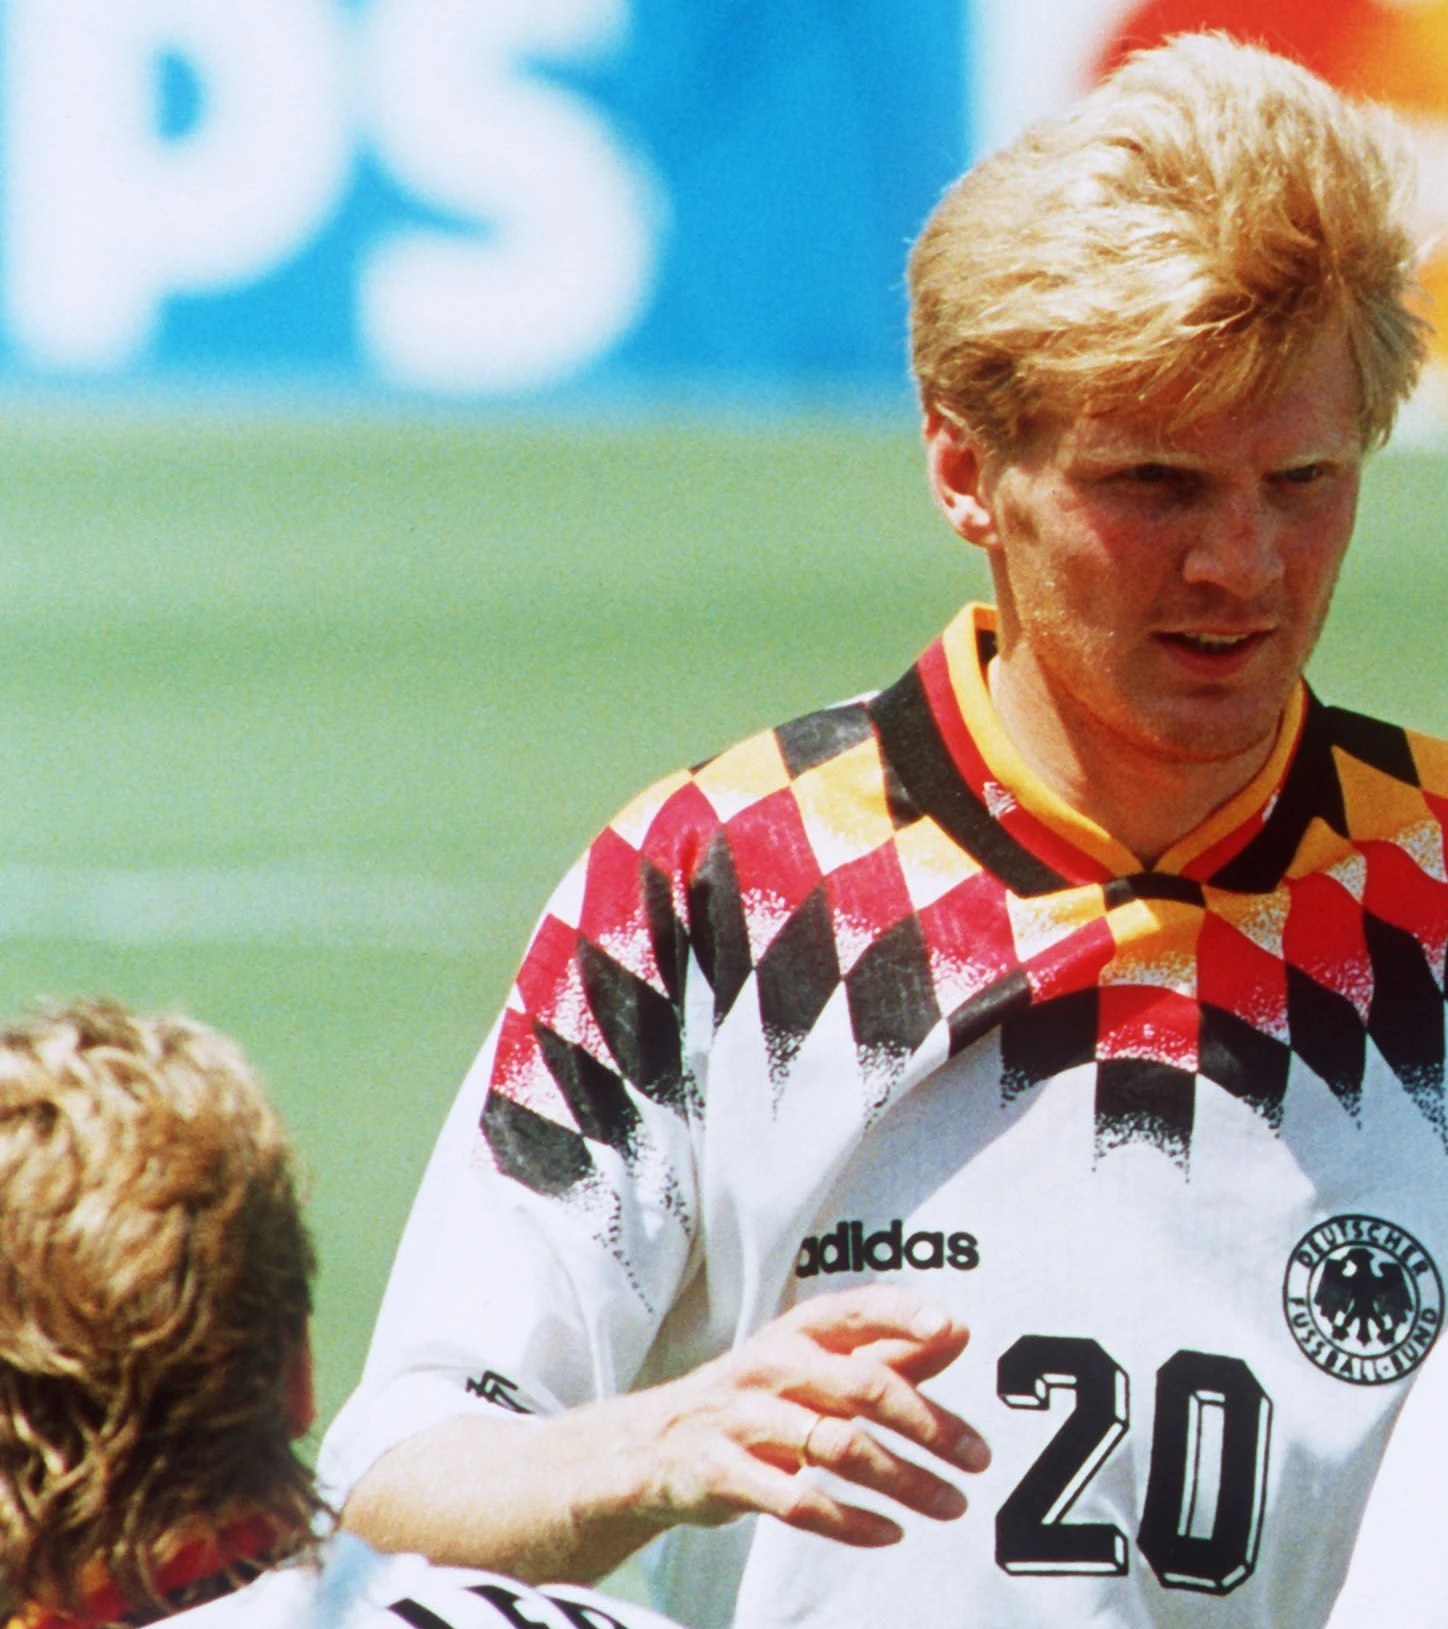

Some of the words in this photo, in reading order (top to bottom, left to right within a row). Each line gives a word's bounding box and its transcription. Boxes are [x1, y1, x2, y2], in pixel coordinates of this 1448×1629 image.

[6, 0, 668, 392] PS
[796, 1219, 979, 1278] adidas
[1296, 1220, 1429, 1276] DEUTSCHER
[996, 1334, 1273, 1595] 20
